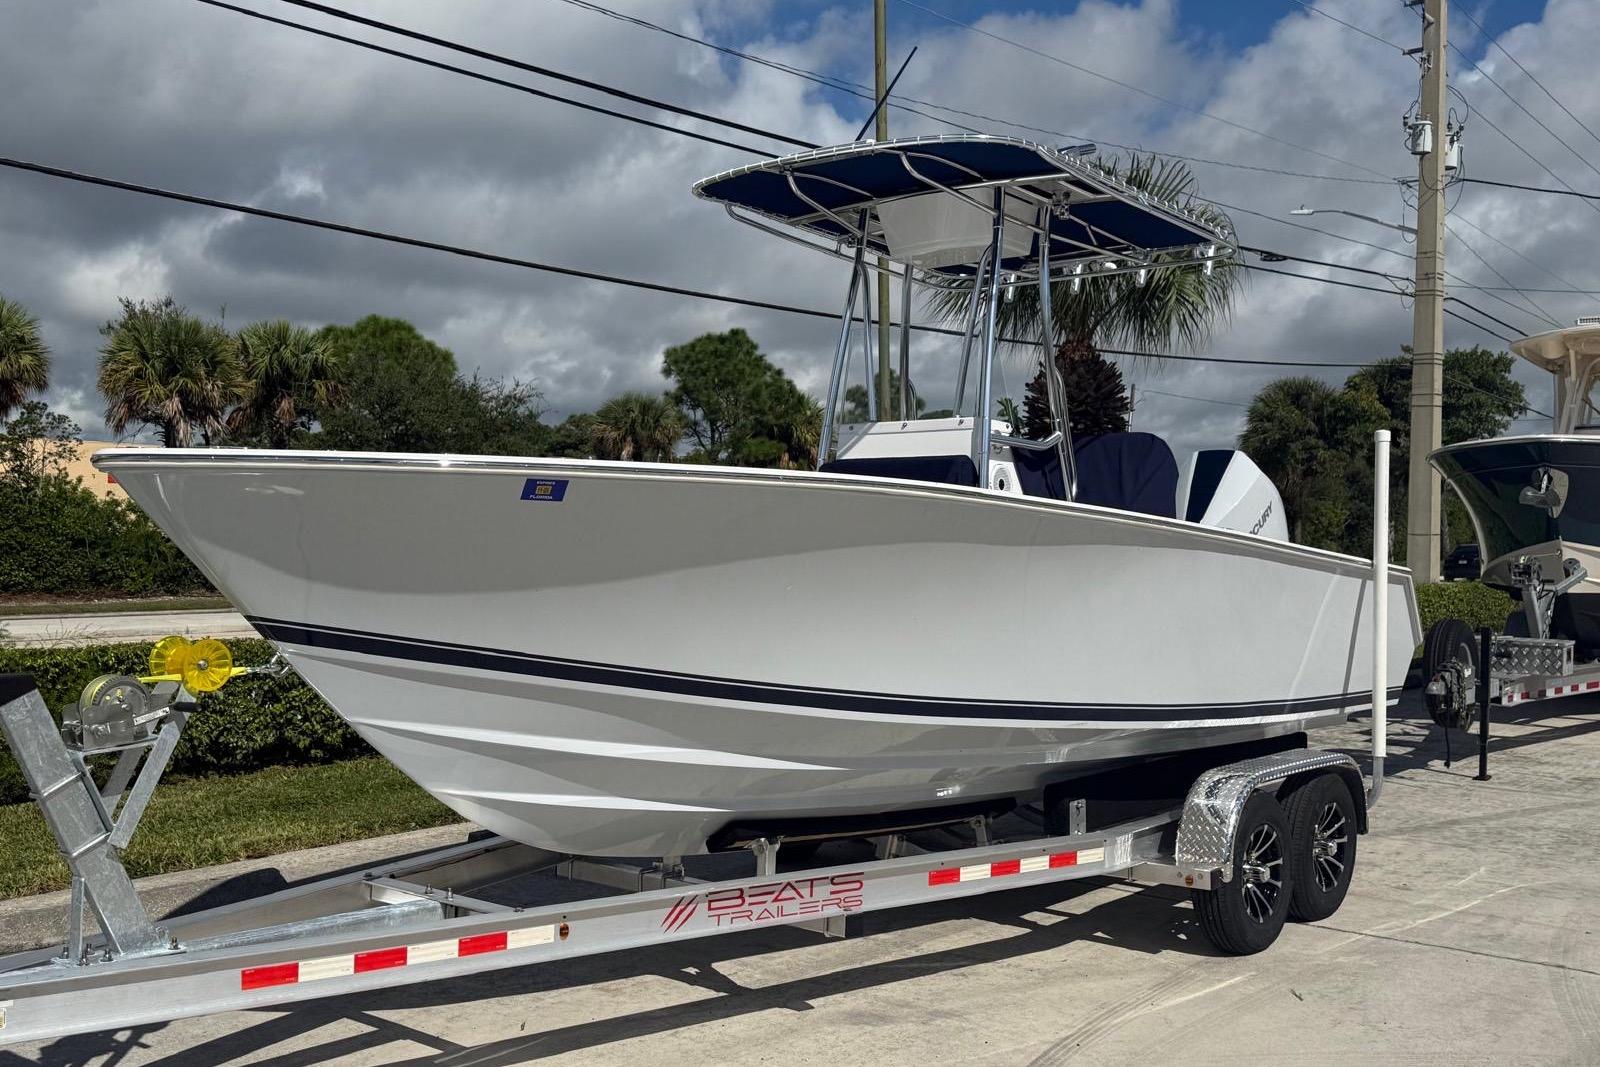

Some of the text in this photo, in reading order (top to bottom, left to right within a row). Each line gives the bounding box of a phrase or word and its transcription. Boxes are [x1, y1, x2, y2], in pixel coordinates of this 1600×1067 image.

[1249, 500, 1272, 535] CURY
[707, 872, 865, 912] BEATS
[708, 894, 864, 926] TRAILERS
